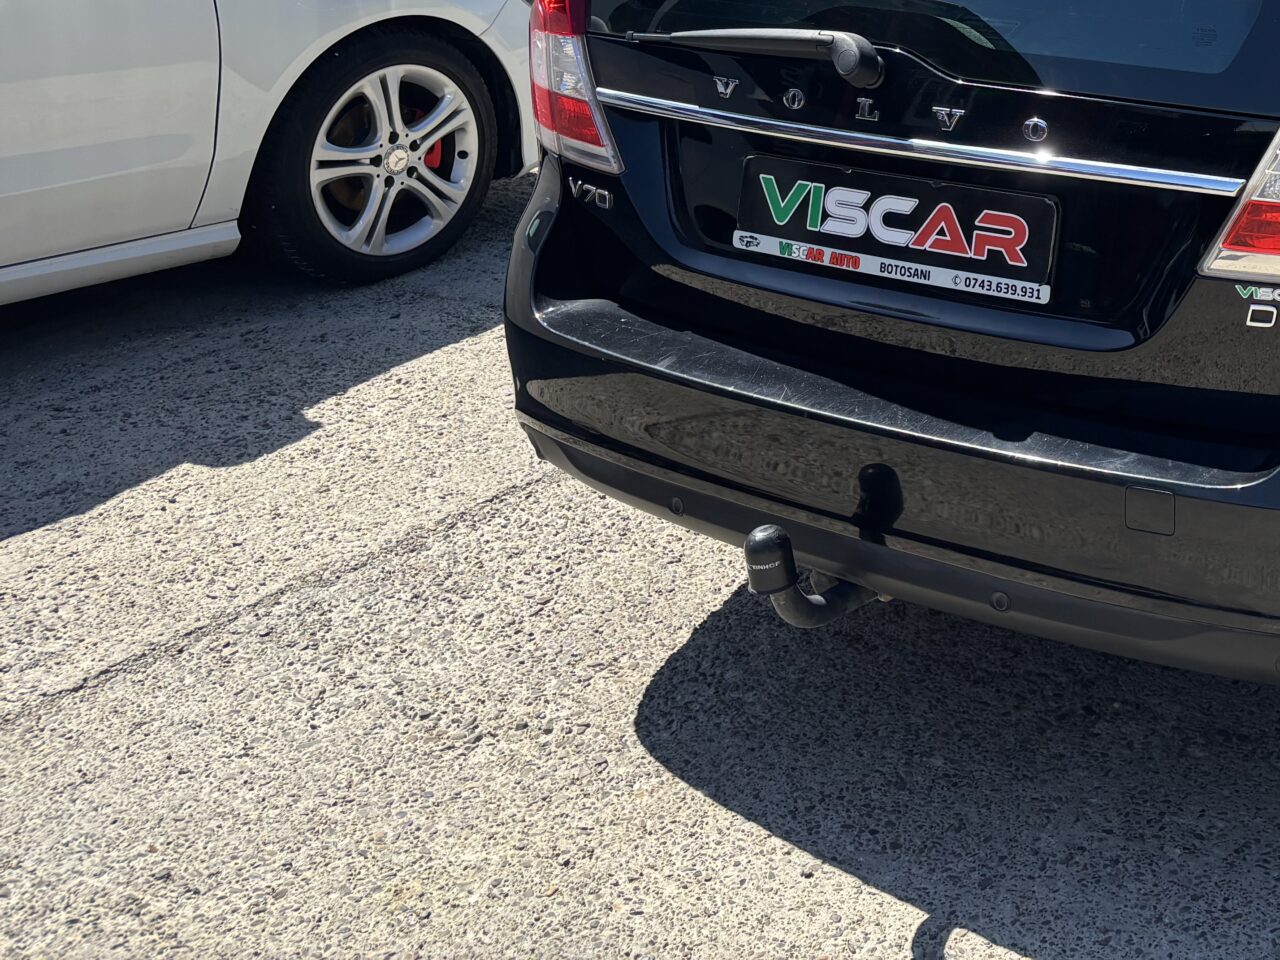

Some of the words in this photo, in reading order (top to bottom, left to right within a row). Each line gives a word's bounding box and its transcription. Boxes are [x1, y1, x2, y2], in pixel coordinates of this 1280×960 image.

[712, 76, 1048, 142] VOLVO
[568, 176, 613, 209] V70
[759, 173, 1029, 267] VISCAR
[778, 241, 825, 264] VISCAR
[828, 251, 861, 270] AUTO
[879, 262, 931, 282] BOTOSANI
[964, 276, 1042, 300] 0743.639.931
